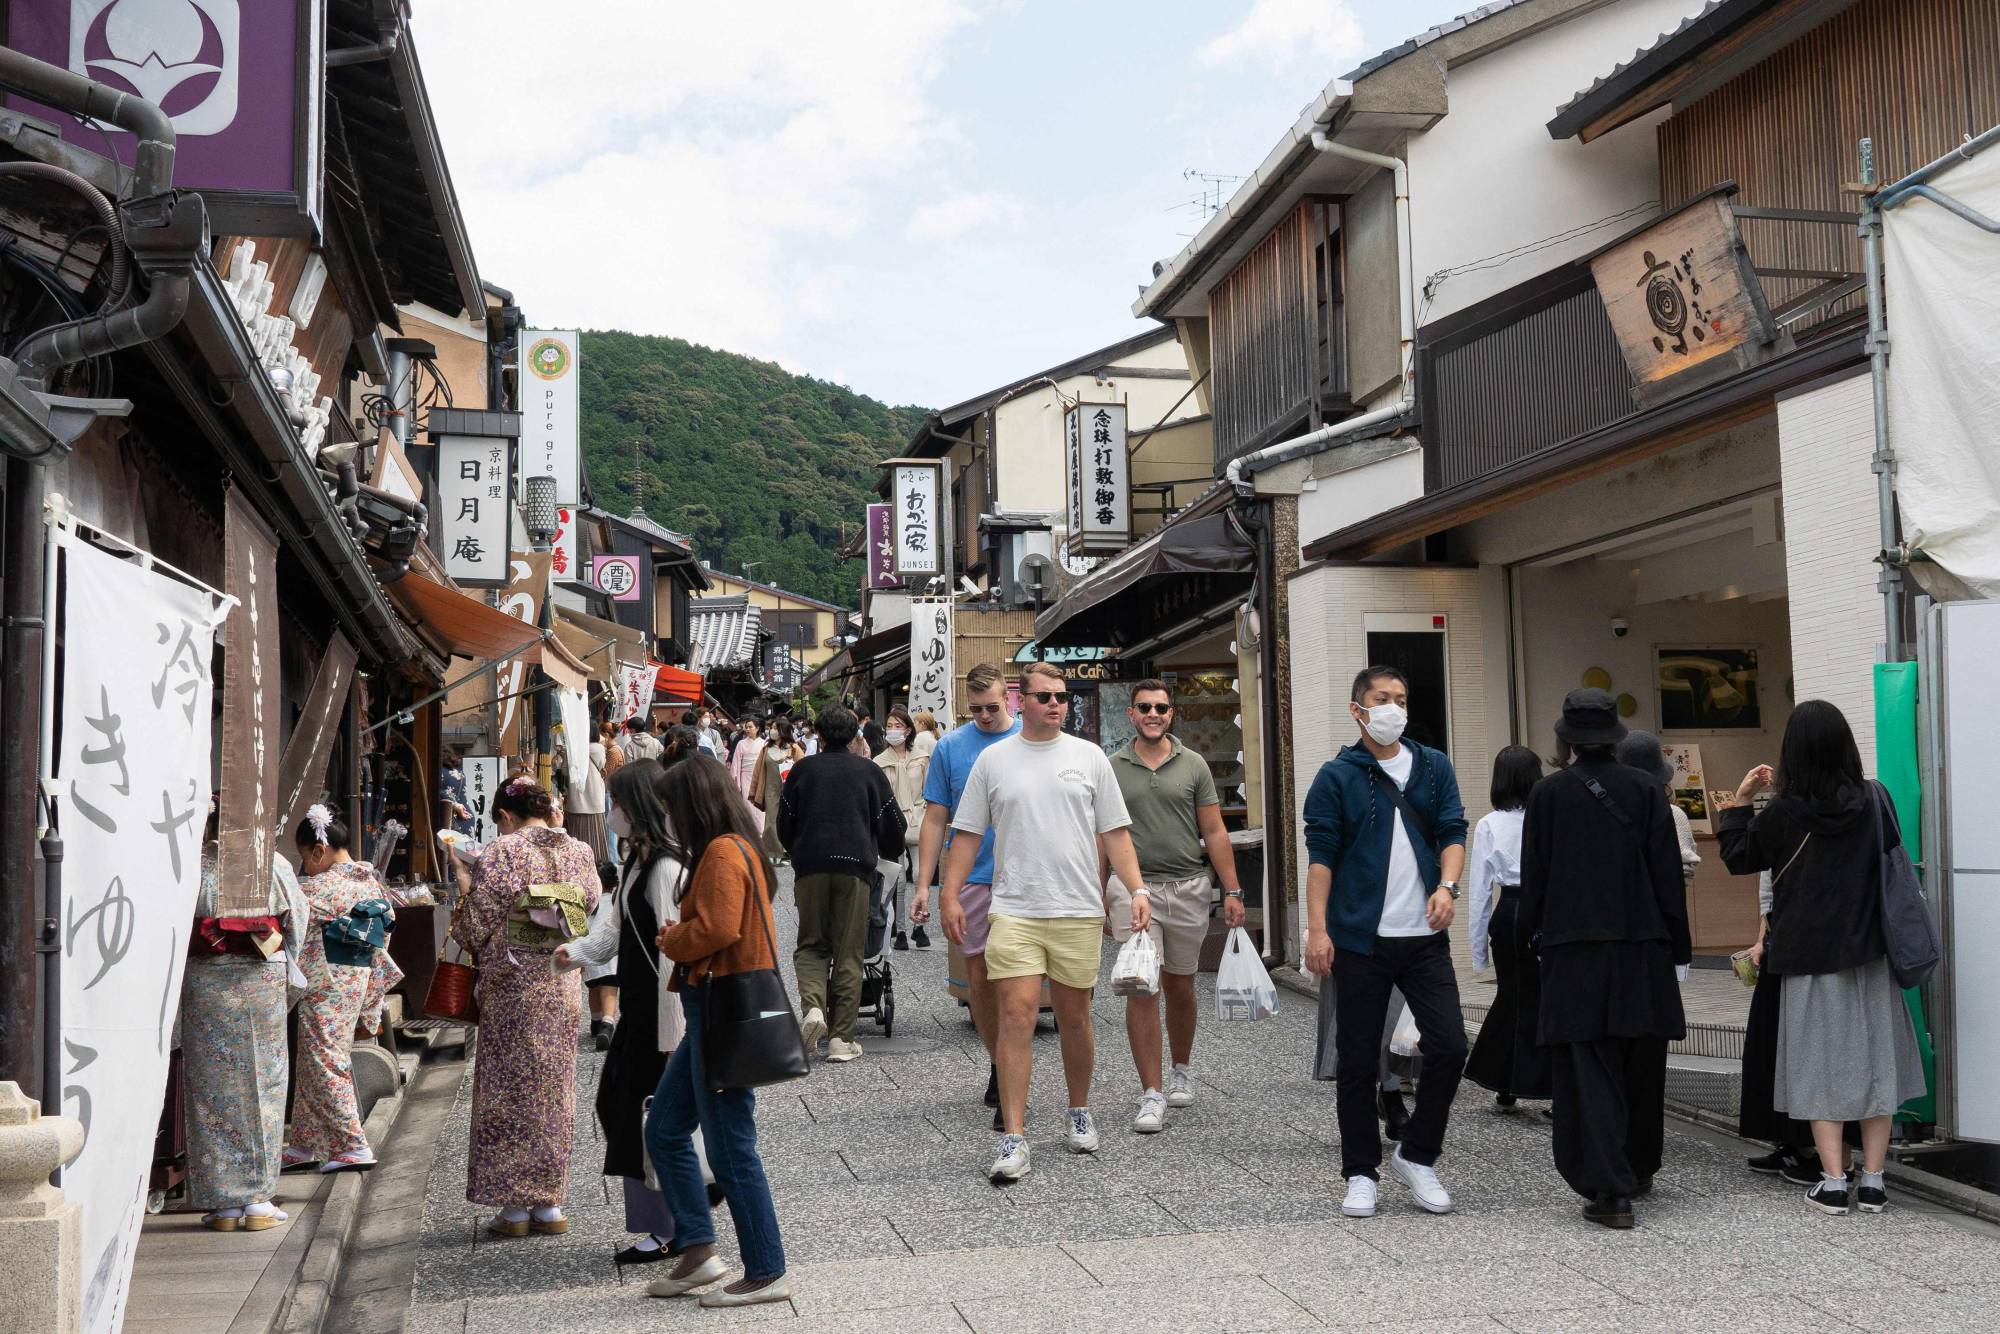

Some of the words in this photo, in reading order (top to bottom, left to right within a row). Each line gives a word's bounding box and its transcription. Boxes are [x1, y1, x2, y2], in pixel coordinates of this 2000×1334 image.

[1636, 250, 1705, 356] 京
[545, 389, 554, 431] pure
[487, 446, 502, 499] 京料理
[545, 441, 554, 477] gre
[450, 459, 486, 563] 日月庵
[904, 487, 929, 553] おかべ家
[609, 565, 625, 591] 西尾
[901, 560, 934, 569] JUNSEI
